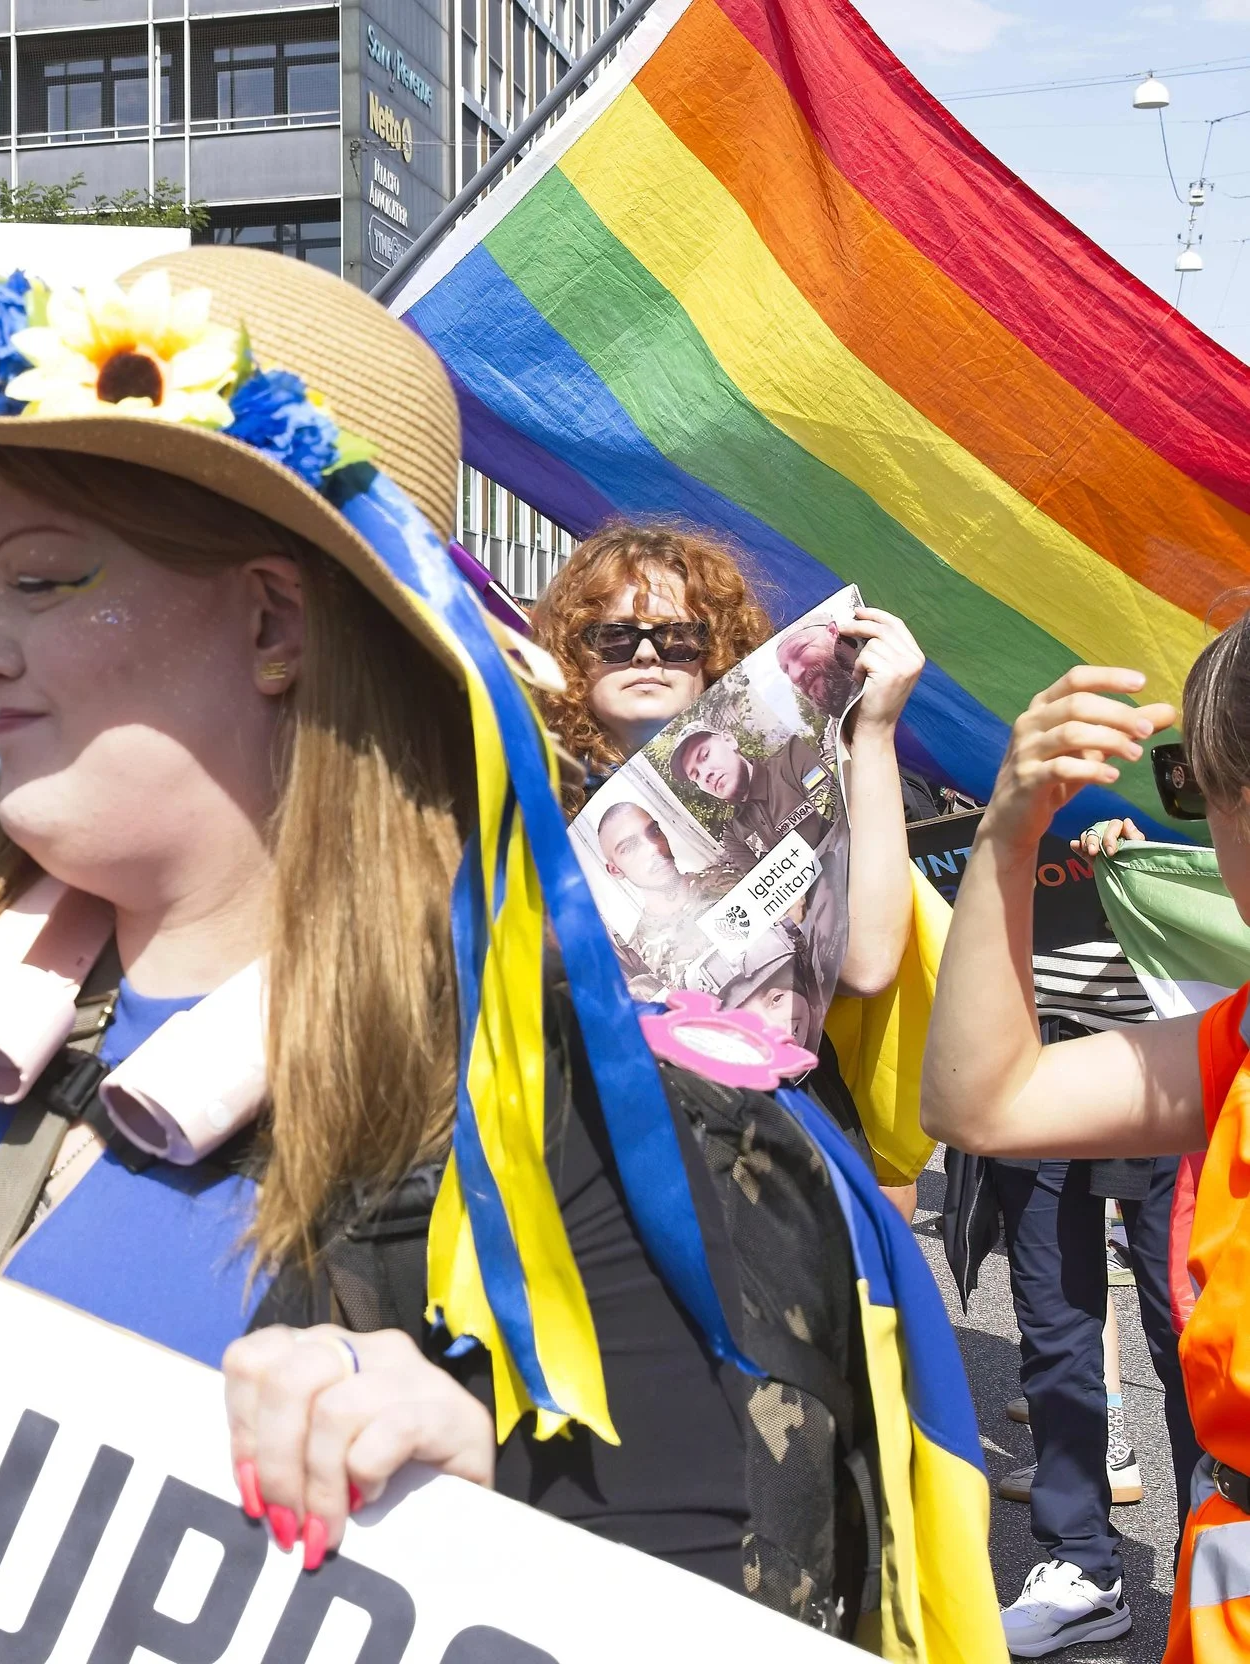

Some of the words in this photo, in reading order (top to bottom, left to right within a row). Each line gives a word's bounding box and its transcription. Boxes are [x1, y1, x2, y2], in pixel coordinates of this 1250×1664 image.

[368, 90, 402, 151] Netto
[750, 847, 802, 901] lgbtiq+
[764, 859, 819, 917] military
